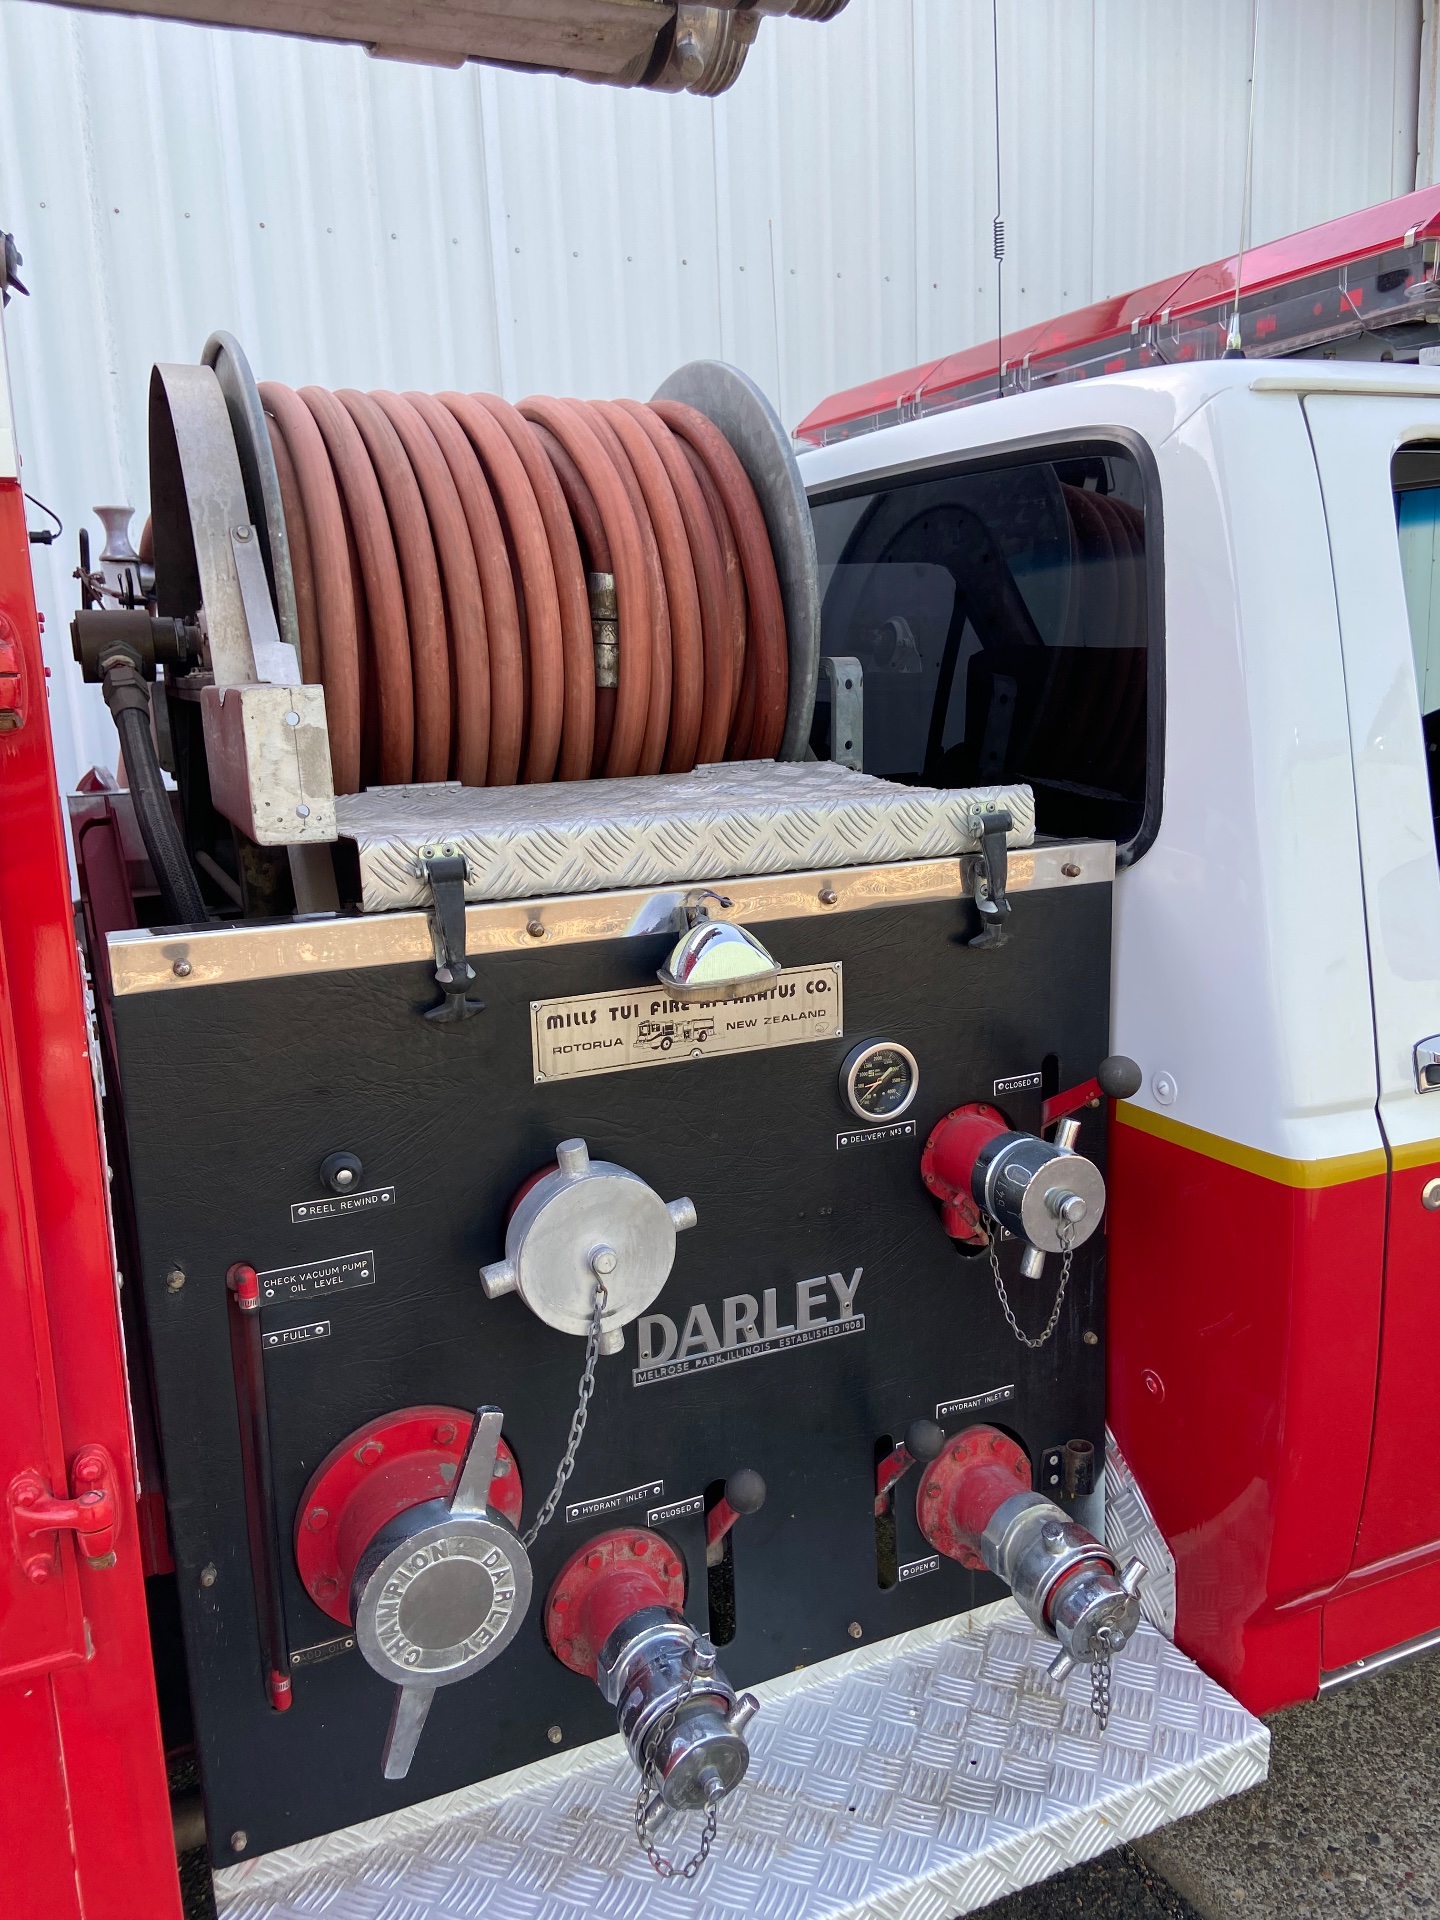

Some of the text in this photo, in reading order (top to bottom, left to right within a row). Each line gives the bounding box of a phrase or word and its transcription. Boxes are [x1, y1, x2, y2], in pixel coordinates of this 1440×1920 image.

[547, 1009, 597, 1030] MILLS
[608, 1003, 639, 1021] TUI
[806, 979, 831, 995] CO.
[552, 1009, 826, 1055] ROTORUA NEW ZEALAND
[1004, 1079, 1032, 1090] CLOSED
[850, 1131, 886, 1143] DELIVERY
[309, 1195, 378, 1215] REEL REWIND
[263, 1260, 368, 1288] CHECK VACUUM PUMP
[290, 1277, 344, 1293] OIL LEVEL
[636, 1266, 864, 1369] DARLEY
[282, 1329, 311, 1342] FULL
[638, 1362, 690, 1383] MELROSE
[727, 1342, 771, 1361] ILLINOIS
[779, 1325, 840, 1348] ESTABLISHED
[842, 1319, 861, 1331] 1908
[949, 1392, 1002, 1412] HYDRANT INLET
[582, 1489, 648, 1514] HYDRANT INLET
[660, 1504, 692, 1519] CLOSED
[910, 1562, 929, 1574] OPEN
[377, 1538, 450, 1666] CHAMPION
[462, 1547, 515, 1661] DARLEY
